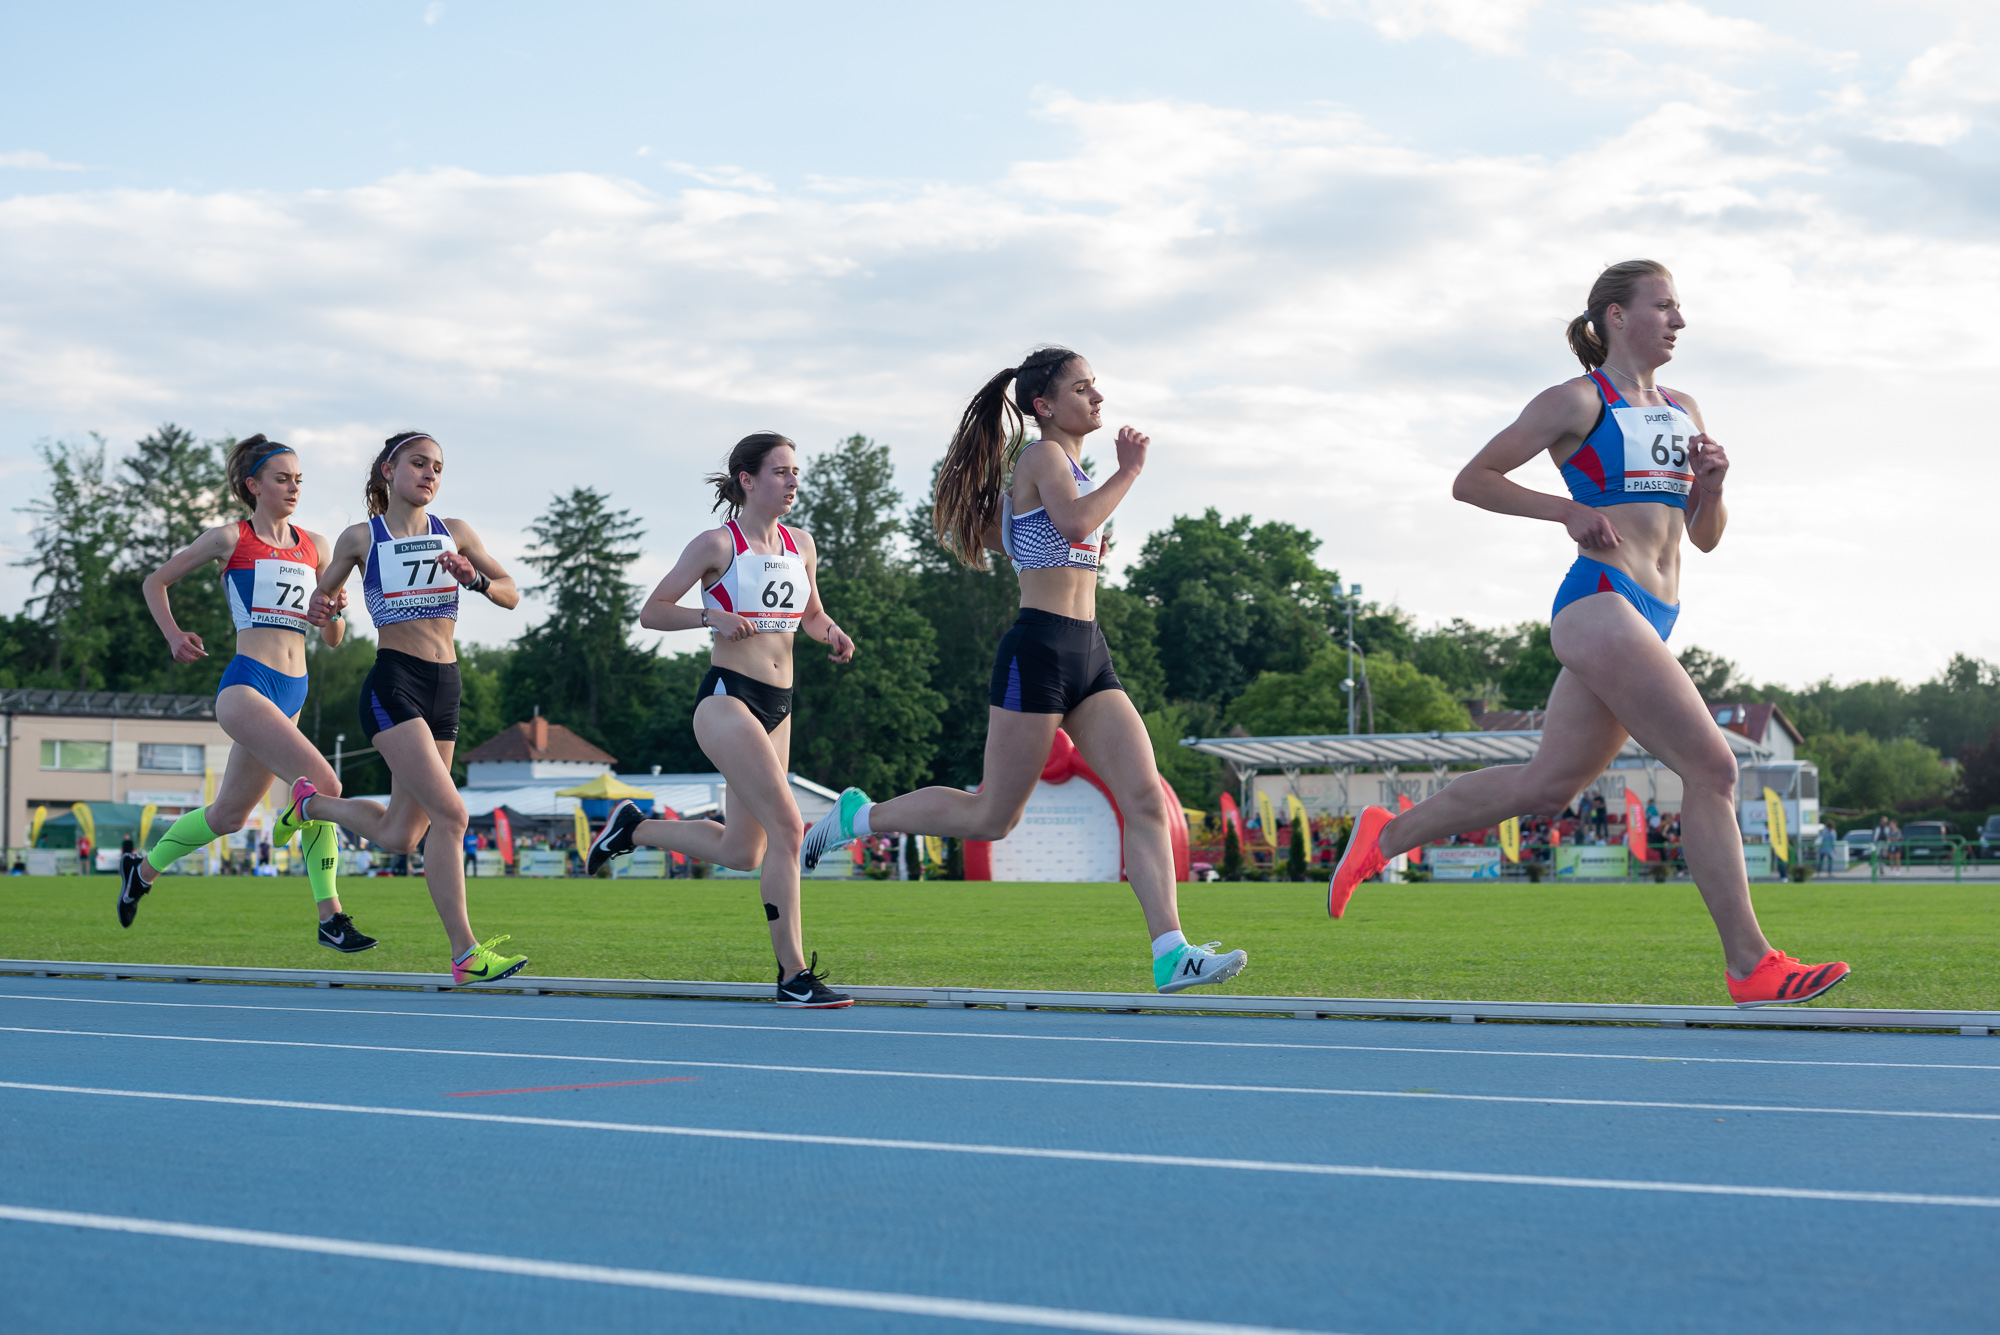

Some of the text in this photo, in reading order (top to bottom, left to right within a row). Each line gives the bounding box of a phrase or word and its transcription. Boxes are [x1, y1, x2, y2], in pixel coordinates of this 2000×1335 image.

[1644, 412, 1678, 424] purella
[1651, 434, 1686, 468] 65
[1633, 480, 1678, 492] PIASECZNO
[1075, 552, 1097, 563] PIASE
[402, 559, 439, 587] 77
[764, 561, 790, 572] purella
[276, 581, 305, 610] 72
[761, 580, 794, 608] 62
[391, 594, 451, 608] PIASECZNO 2021
[257, 614, 298, 627] PIASECZNO
